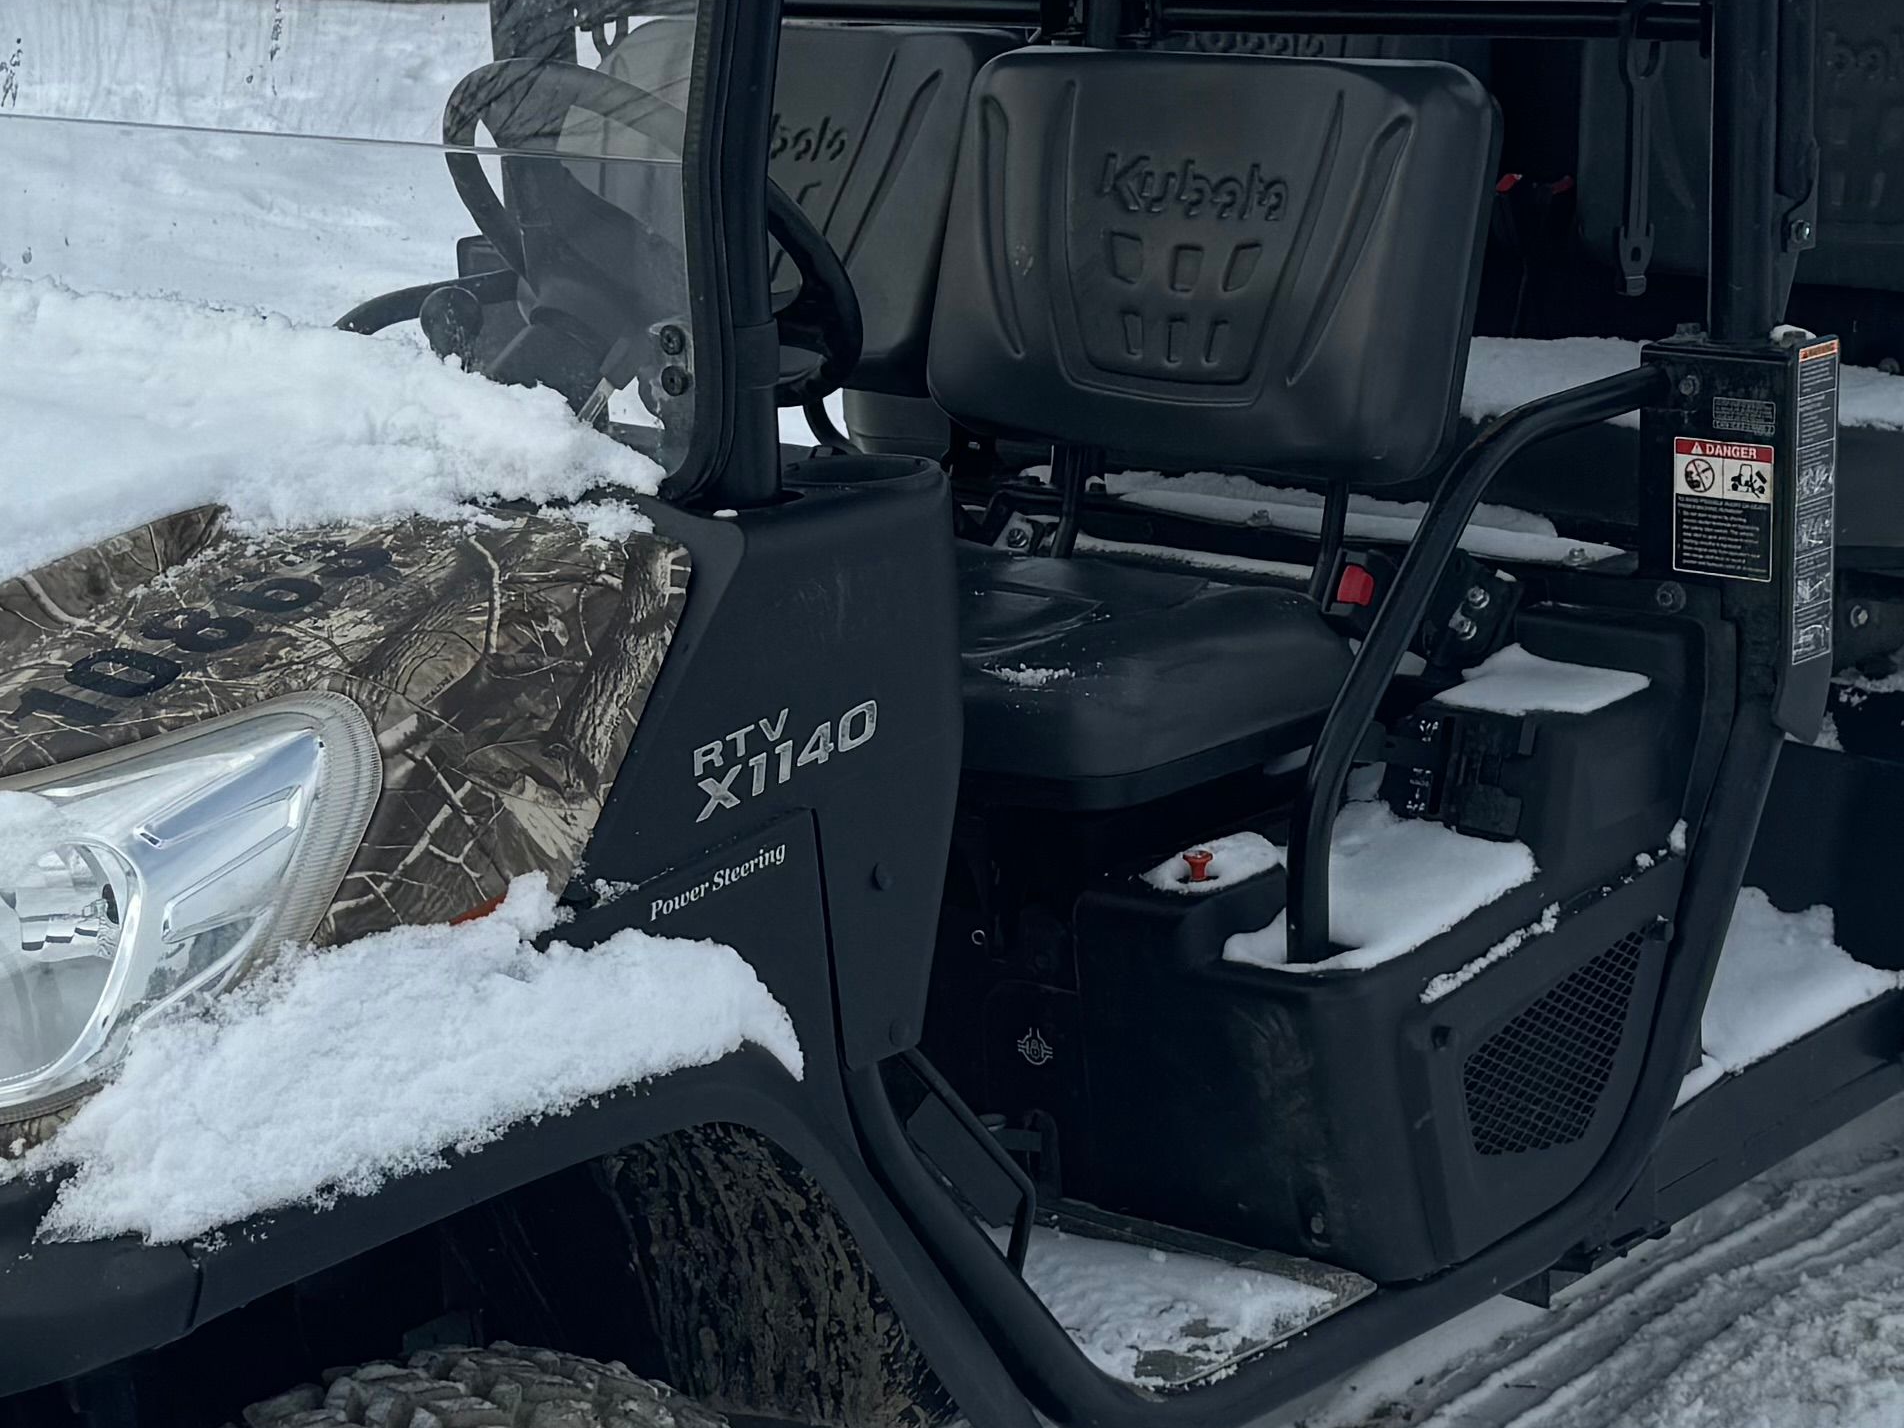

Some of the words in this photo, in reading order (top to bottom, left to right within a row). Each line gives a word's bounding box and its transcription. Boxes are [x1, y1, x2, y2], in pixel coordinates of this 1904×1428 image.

[1099, 152, 1289, 221] Kubota
[1705, 443, 1757, 460] DANGER
[693, 707, 790, 777] RTV
[696, 699, 878, 823] X1140
[650, 881, 710, 922] Power
[712, 843, 786, 892] Steering
